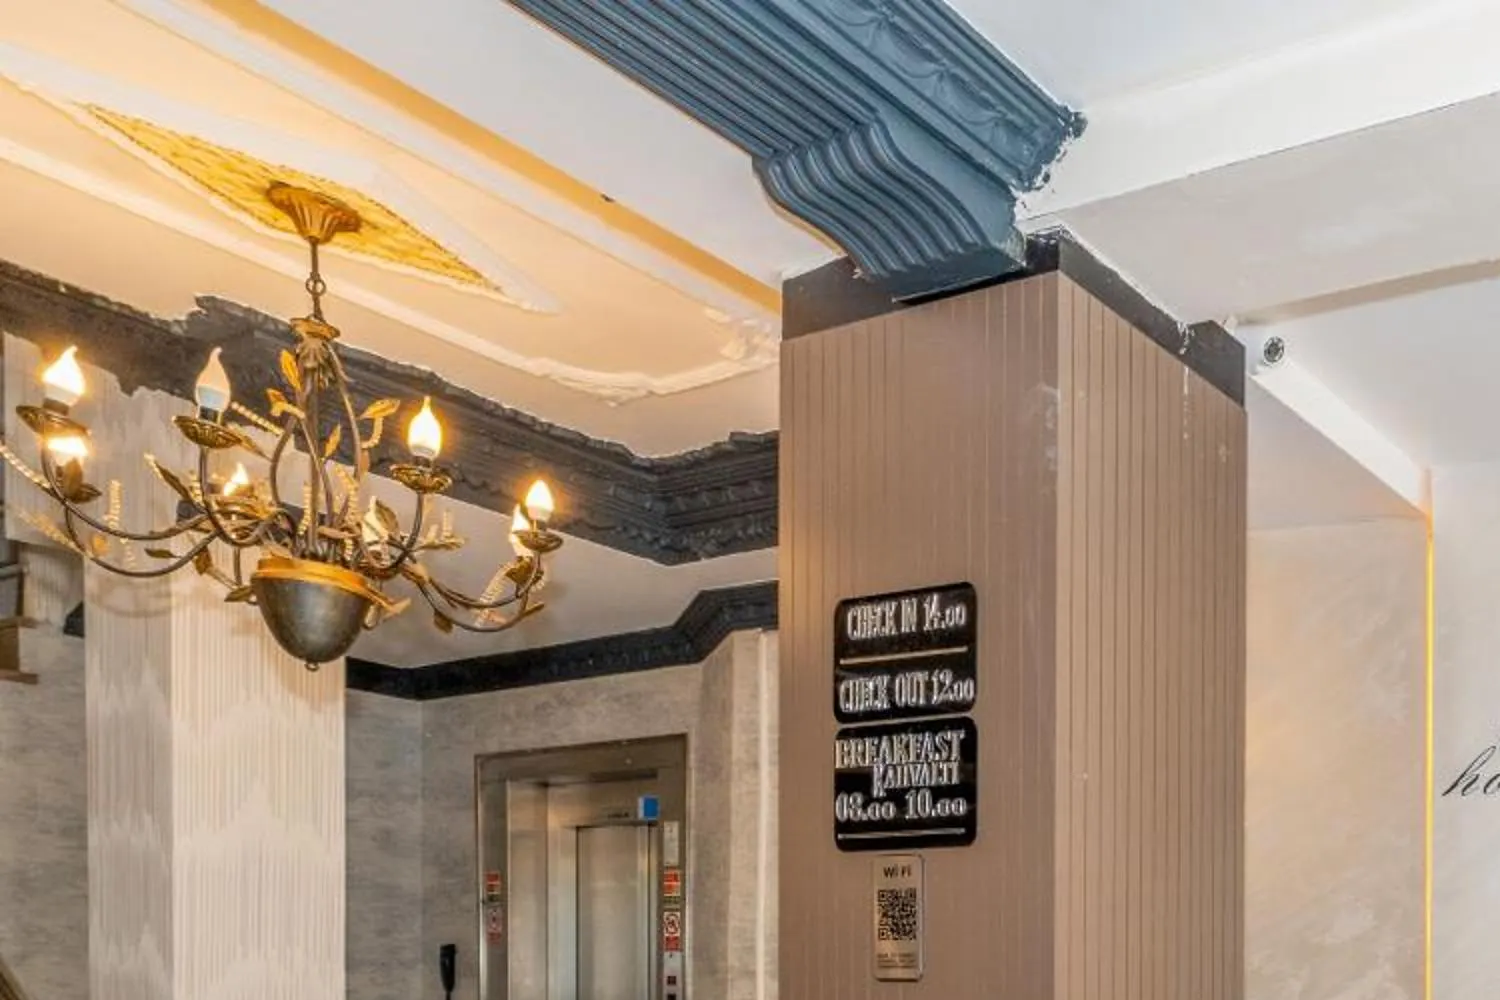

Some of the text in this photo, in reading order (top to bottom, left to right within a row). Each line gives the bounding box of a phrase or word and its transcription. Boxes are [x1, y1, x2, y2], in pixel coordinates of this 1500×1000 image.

[847, 600, 898, 640] CHECK
[901, 598, 918, 633] IN
[839, 669, 974, 712] CHECK OUT 12.00
[835, 729, 965, 769] BREAKFAST
[904, 788, 967, 819] 10.00
